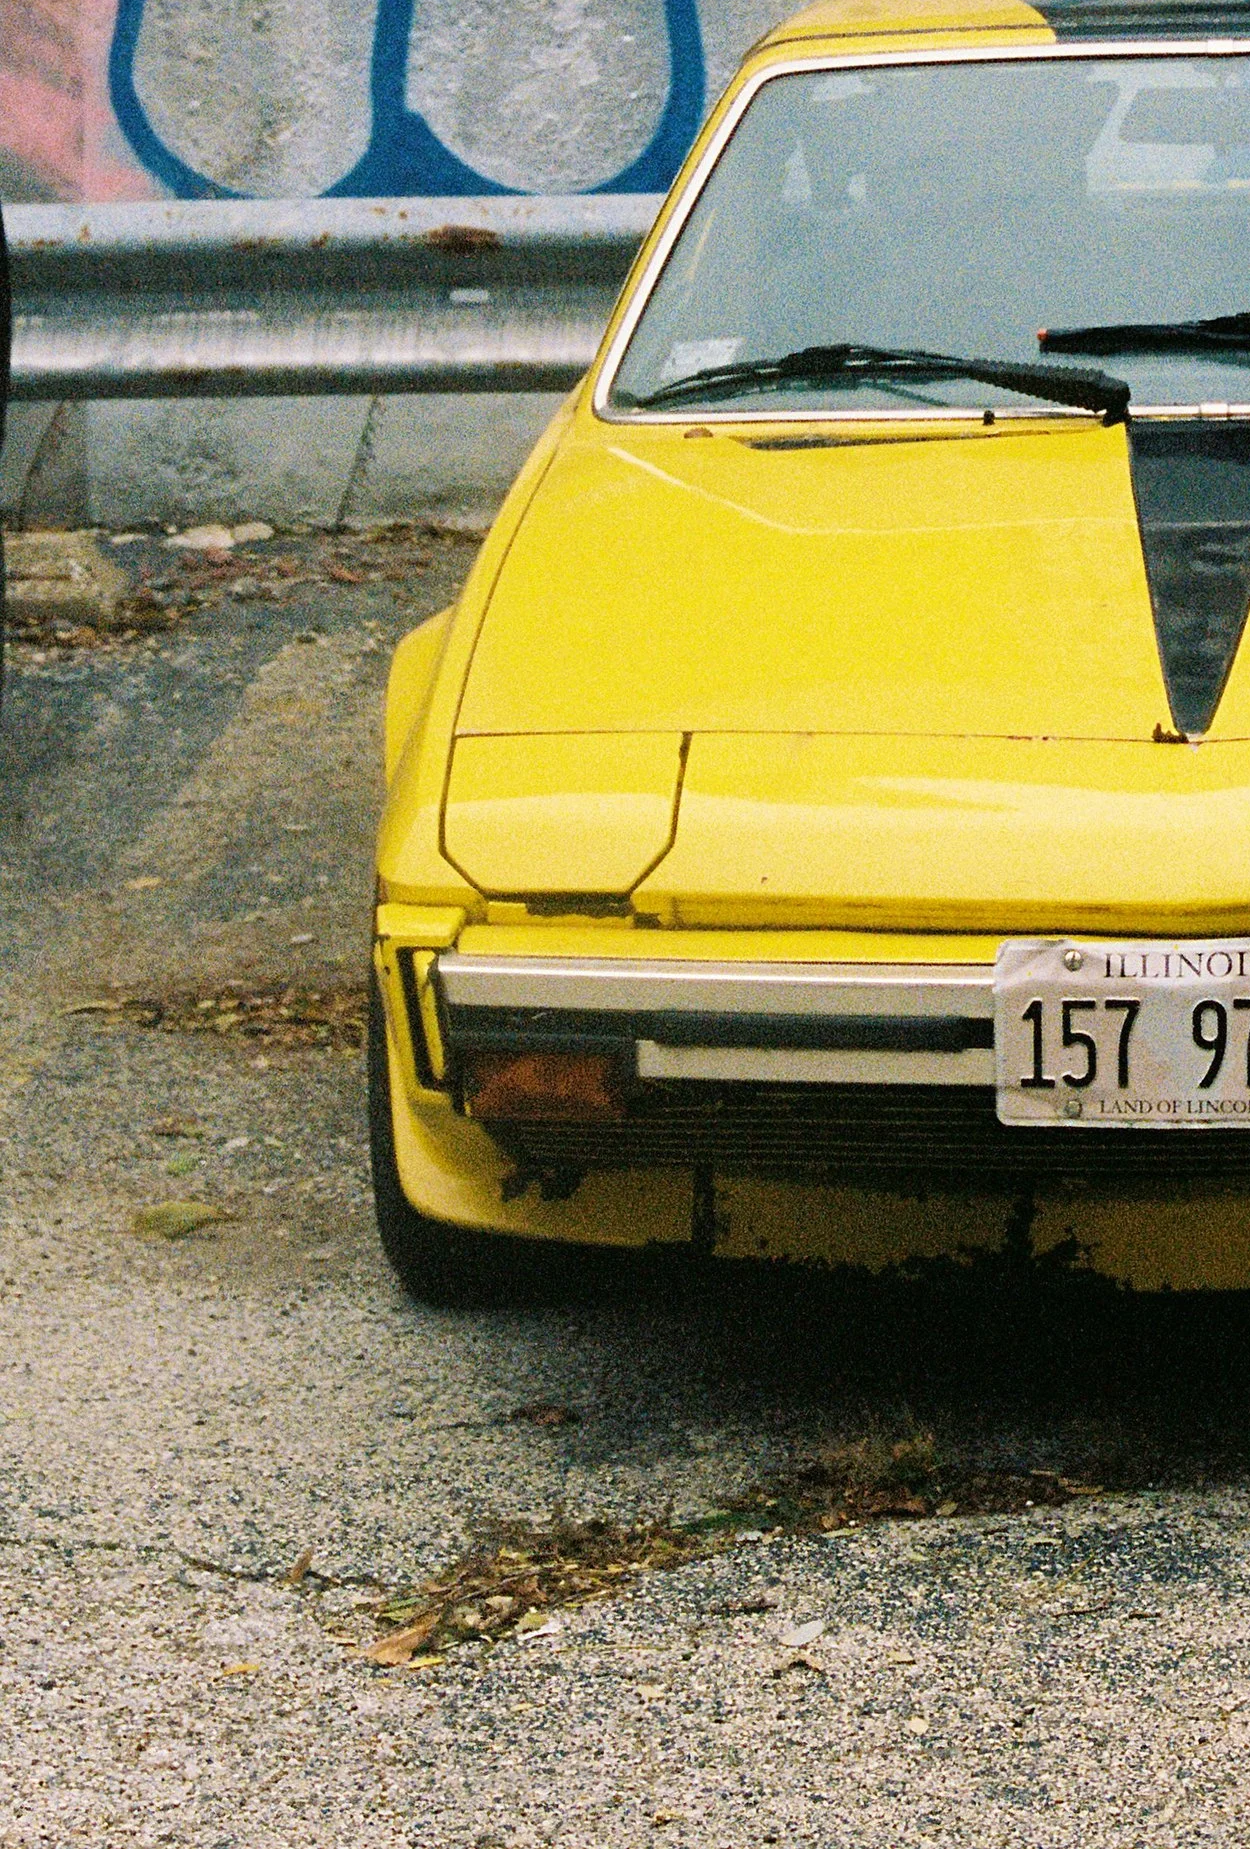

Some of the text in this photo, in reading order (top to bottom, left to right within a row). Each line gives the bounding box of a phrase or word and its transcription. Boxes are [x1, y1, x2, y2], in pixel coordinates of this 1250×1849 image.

[1020, 997, 1141, 1089] 157
[1100, 1098, 1153, 1116] LAND
[1157, 1098, 1184, 1116] OF
